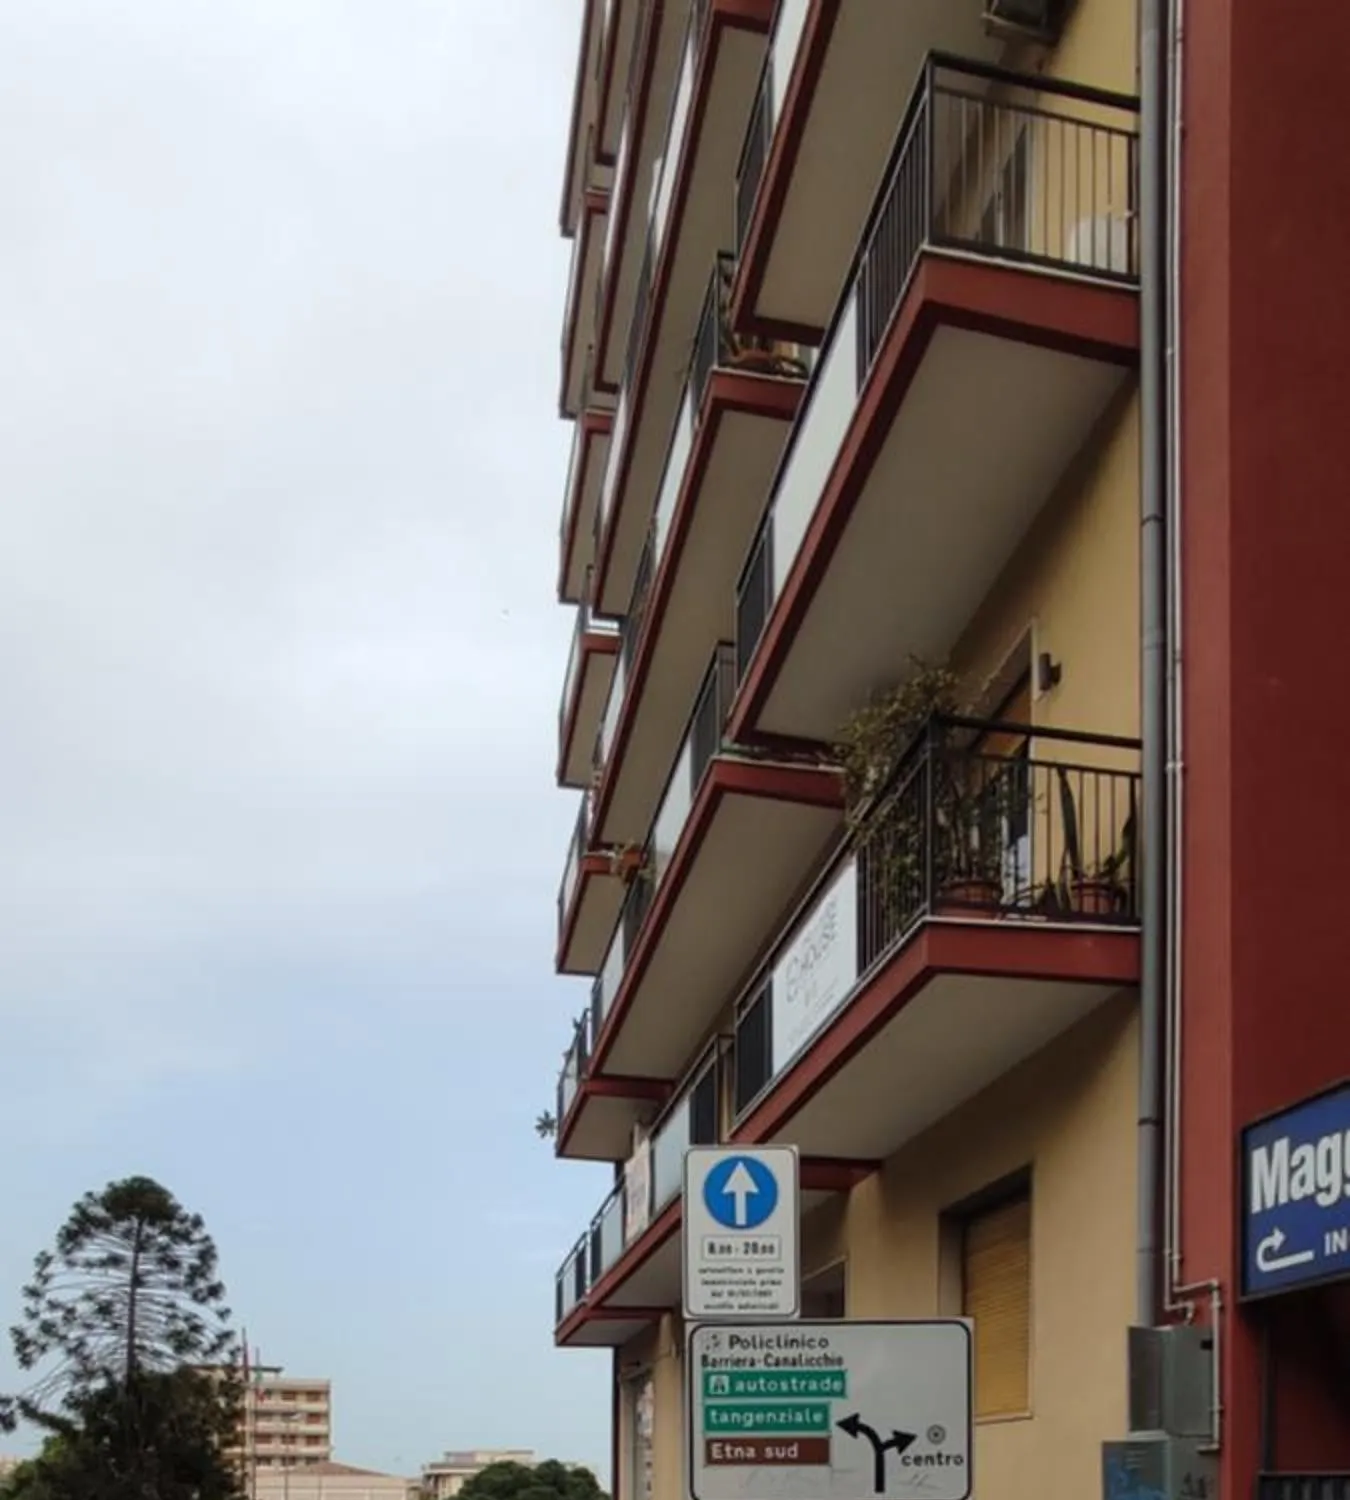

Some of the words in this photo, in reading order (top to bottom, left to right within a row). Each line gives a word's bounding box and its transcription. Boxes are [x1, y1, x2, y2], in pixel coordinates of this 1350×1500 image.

[728, 1334, 829, 1350] Policlinico
[734, 1377, 844, 1393] autostrade
[710, 1407, 824, 1428] tangenziale
[711, 1443, 756, 1460] Etna
[764, 1443, 799, 1459] sud
[901, 1450, 964, 1468] centro
